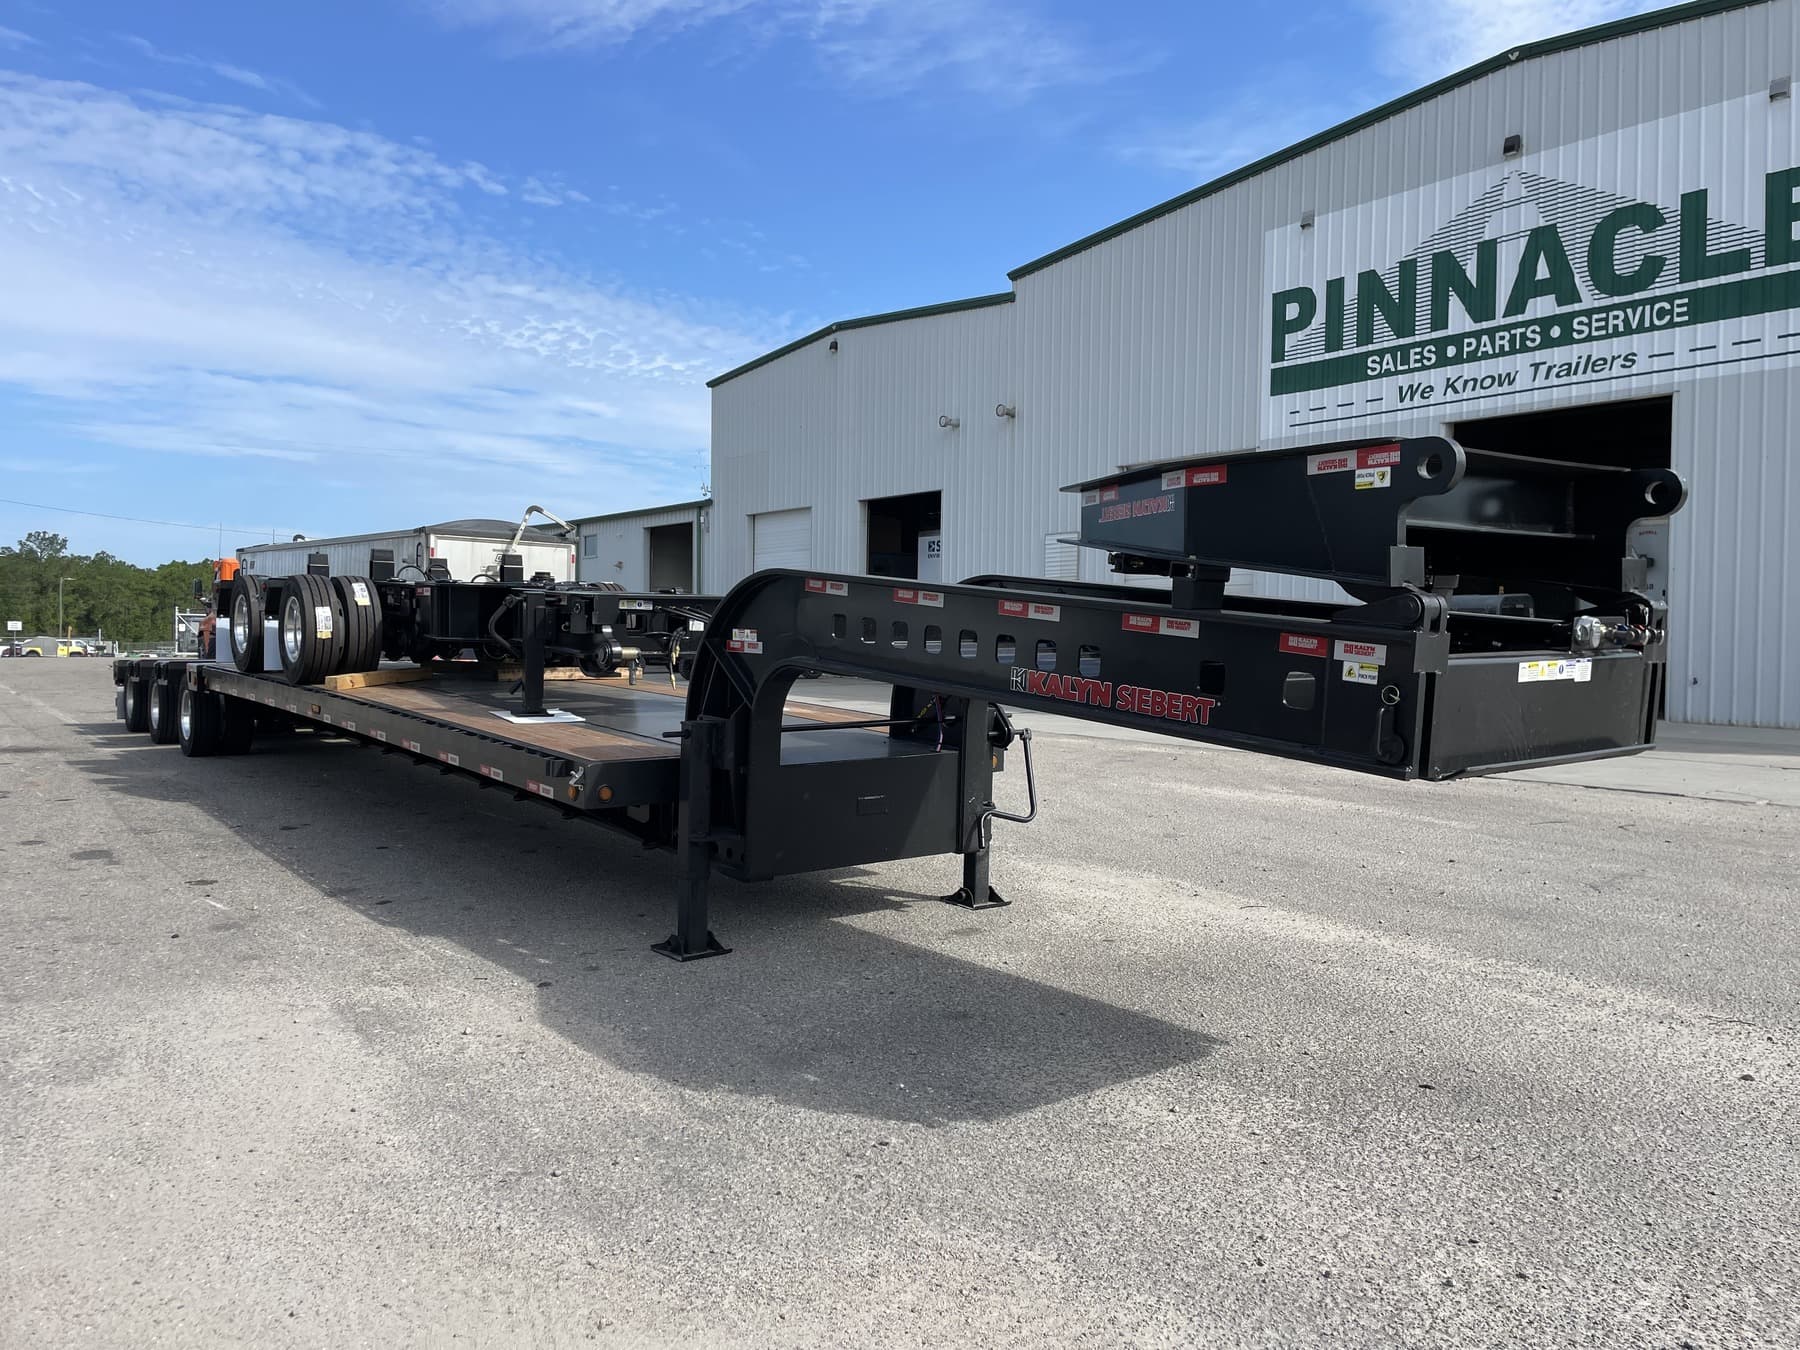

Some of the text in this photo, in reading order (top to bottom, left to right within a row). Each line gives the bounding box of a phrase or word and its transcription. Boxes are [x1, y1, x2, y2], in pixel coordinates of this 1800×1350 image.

[1271, 166, 1800, 364] PINNACLE
[1367, 298, 1690, 376] SALES PARTS SERVICE
[1398, 351, 1638, 404] We Know Trailers
[1028, 669, 1215, 725] KALYN SIEBERT
